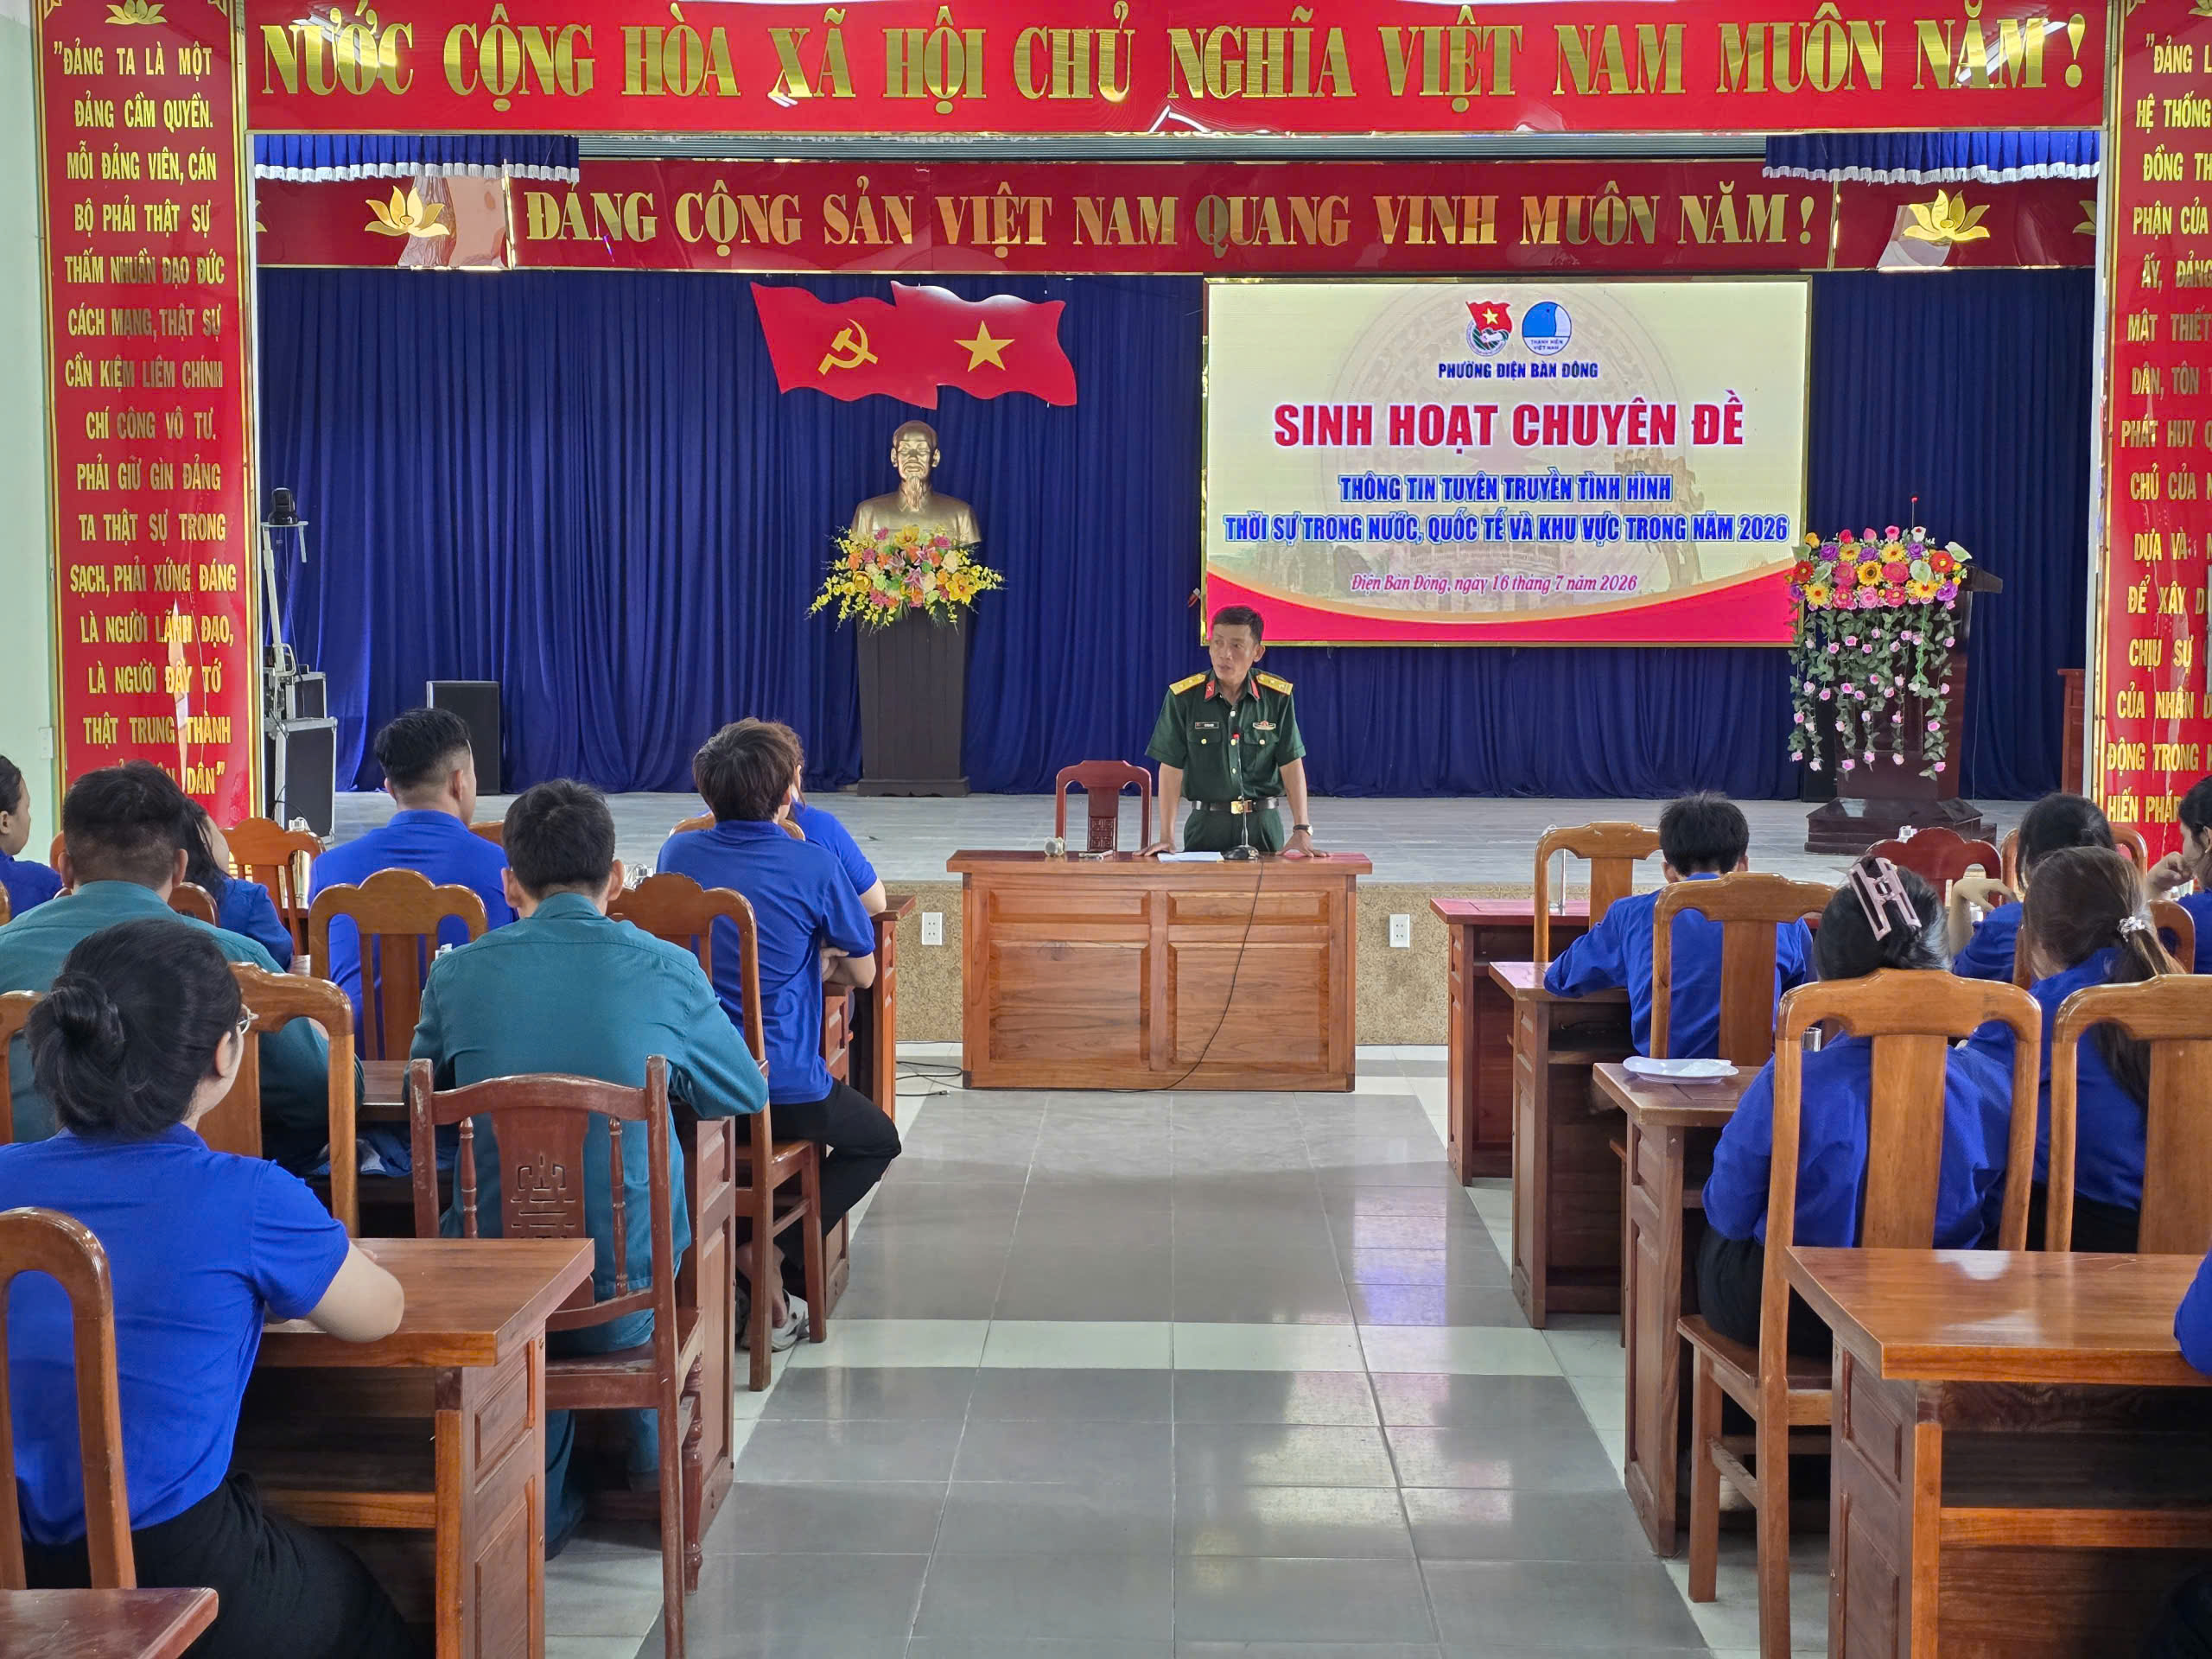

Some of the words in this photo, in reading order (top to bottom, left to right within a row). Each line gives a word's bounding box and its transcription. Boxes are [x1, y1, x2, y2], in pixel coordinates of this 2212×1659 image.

[116, 48, 136, 75] TA
[145, 41, 165, 75] LÀ
[178, 41, 213, 82] MỘT
[260, 0, 414, 96] NƯỚC
[443, 3, 595, 112] CỘNG
[620, 3, 741, 97] HÒA
[767, 7, 856, 98] XÃ
[882, 6, 986, 114] HỘI
[1014, 1, 1135, 103] CHỦ
[1167, 7, 1357, 99] NGHĨA
[1378, 4, 1523, 113] VIỆT
[1554, 23, 1688, 96] NAM
[1716, 6, 1885, 92] MUÔN
[74, 90, 115, 128] ĐẢNG
[124, 92, 156, 128] CẦM
[163, 92, 213, 133] QUYỀN.
[2135, 92, 2155, 134] HỆ
[2163, 90, 2211, 129] THỐNG
[67, 140, 93, 180] MỖI
[101, 142, 140, 180] ĐẢNG
[147, 146, 184, 186] VIÊN,
[188, 146, 217, 181] CÁN
[2143, 143, 2183, 181] ĐỒNG
[74, 197, 94, 238] BỘ
[102, 194, 136, 232] PHẢI
[144, 198, 181, 238] THẬT
[191, 199, 212, 238] SỰ
[675, 179, 803, 257] CỘNG
[823, 175, 914, 245] SẢN
[934, 181, 1052, 258] VIỆT
[1072, 196, 1179, 245] NAM
[1195, 194, 1352, 257] QUANG
[1373, 195, 1498, 245] VINH
[1521, 180, 1660, 245] MUÔN
[2133, 200, 2172, 240] PHẬN
[2180, 196, 2209, 235] CỦA
[64, 247, 105, 283] THẤM
[110, 247, 156, 284] NHUẦN
[162, 256, 190, 289] ĐẠO
[196, 248, 225, 284] ĐỨC
[2176, 249, 2212, 288] ĐẢNG
[67, 302, 105, 336] CÁCH
[158, 302, 195, 341] THẬT
[202, 303, 221, 342] SỰ
[2127, 308, 2158, 347] MẬT
[2170, 304, 2212, 341] THIẾT
[65, 351, 92, 387] CẦN
[100, 353, 135, 393] KIỆM
[142, 353, 175, 388] LIÊM
[181, 354, 223, 388] CHÍNH
[1438, 361, 1492, 378] PHƯỜNG
[1497, 360, 1526, 381] ĐIỆN
[1530, 360, 1557, 378] BÀN
[1561, 360, 1599, 378] ĐÔNG
[2171, 359, 2199, 395] TÔN
[86, 405, 110, 440] CHÍ
[117, 405, 156, 440] CÔNG
[165, 405, 184, 440] VÔ
[1274, 404, 1373, 447] SINH
[1389, 404, 1499, 454] HOẠT
[1512, 397, 1677, 447] CHUYÊN
[1690, 389, 1745, 446] ĐỀ
[2120, 413, 2158, 448] PHÁT
[2166, 420, 2196, 448] HUY
[77, 453, 110, 491] PHẢI
[149, 456, 174, 490] GÌN
[182, 453, 221, 491] ĐẢNG
[1338, 471, 1402, 502] THÔNG
[1404, 475, 1438, 502] TIN
[1440, 471, 1498, 502] TUYÊN
[1503, 467, 1573, 502] TRUYỀN
[1577, 472, 1622, 502] TÌNH
[1624, 472, 1673, 502] HÌNH
[2130, 462, 2159, 500] CHỦ
[2167, 462, 2197, 500] CỦA
[78, 513, 97, 541] TA
[103, 507, 139, 546] THẬT
[149, 508, 168, 547] SỰ
[179, 512, 226, 541] TRONG
[1224, 511, 1268, 542] THỜI
[1271, 512, 1300, 545] SỰ
[1301, 515, 1364, 542] TRONG
[1366, 512, 1424, 544] NƯỚC,
[1427, 507, 1479, 544] QUỐC
[1481, 507, 1508, 542] TẾ
[1508, 511, 1535, 542] VÀ
[1537, 514, 1579, 542] KHU
[1580, 511, 1622, 546] VỰC
[1624, 515, 1688, 542] TRONG
[1690, 510, 1735, 542] NĂM
[1737, 514, 1789, 542] 2026
[2134, 528, 2163, 568] DỰA
[2171, 525, 2188, 560] VÀ
[69, 564, 111, 599] SẠCH,
[114, 555, 147, 592] PHẢI
[153, 556, 191, 592] XỨNG
[199, 558, 237, 592] ĐÁNG
[1351, 574, 1381, 594] Điện
[1383, 574, 1410, 591] Bàn
[1454, 575, 1488, 594] ngày
[1492, 575, 1509, 591] 16
[1512, 574, 1551, 594] tháng
[1554, 575, 1564, 591] 7
[1566, 575, 1597, 591] năm
[1599, 575, 1637, 591] 2026
[2127, 574, 2151, 614] ĐỂ
[2158, 580, 2187, 615] XÂY
[79, 610, 99, 643] LÀ
[105, 607, 148, 643] NGƯỜI
[200, 614, 234, 648] ĐẠO,
[2129, 639, 2162, 672] CHỊU
[2173, 634, 2194, 674] SỰ
[88, 660, 107, 694] LÀ
[114, 658, 156, 694] NGƯỜI
[202, 658, 222, 694] TỚ
[2117, 681, 2145, 719] CỦA
[2155, 686, 2195, 720] NHÂN
[83, 711, 118, 750] THẬT
[129, 715, 175, 744] TRUNG
[186, 709, 232, 744] THÀNH
[2107, 736, 2146, 777] ĐỘNG
[2152, 742, 2199, 772] TRONG
[2107, 786, 2139, 823] HIẾN
